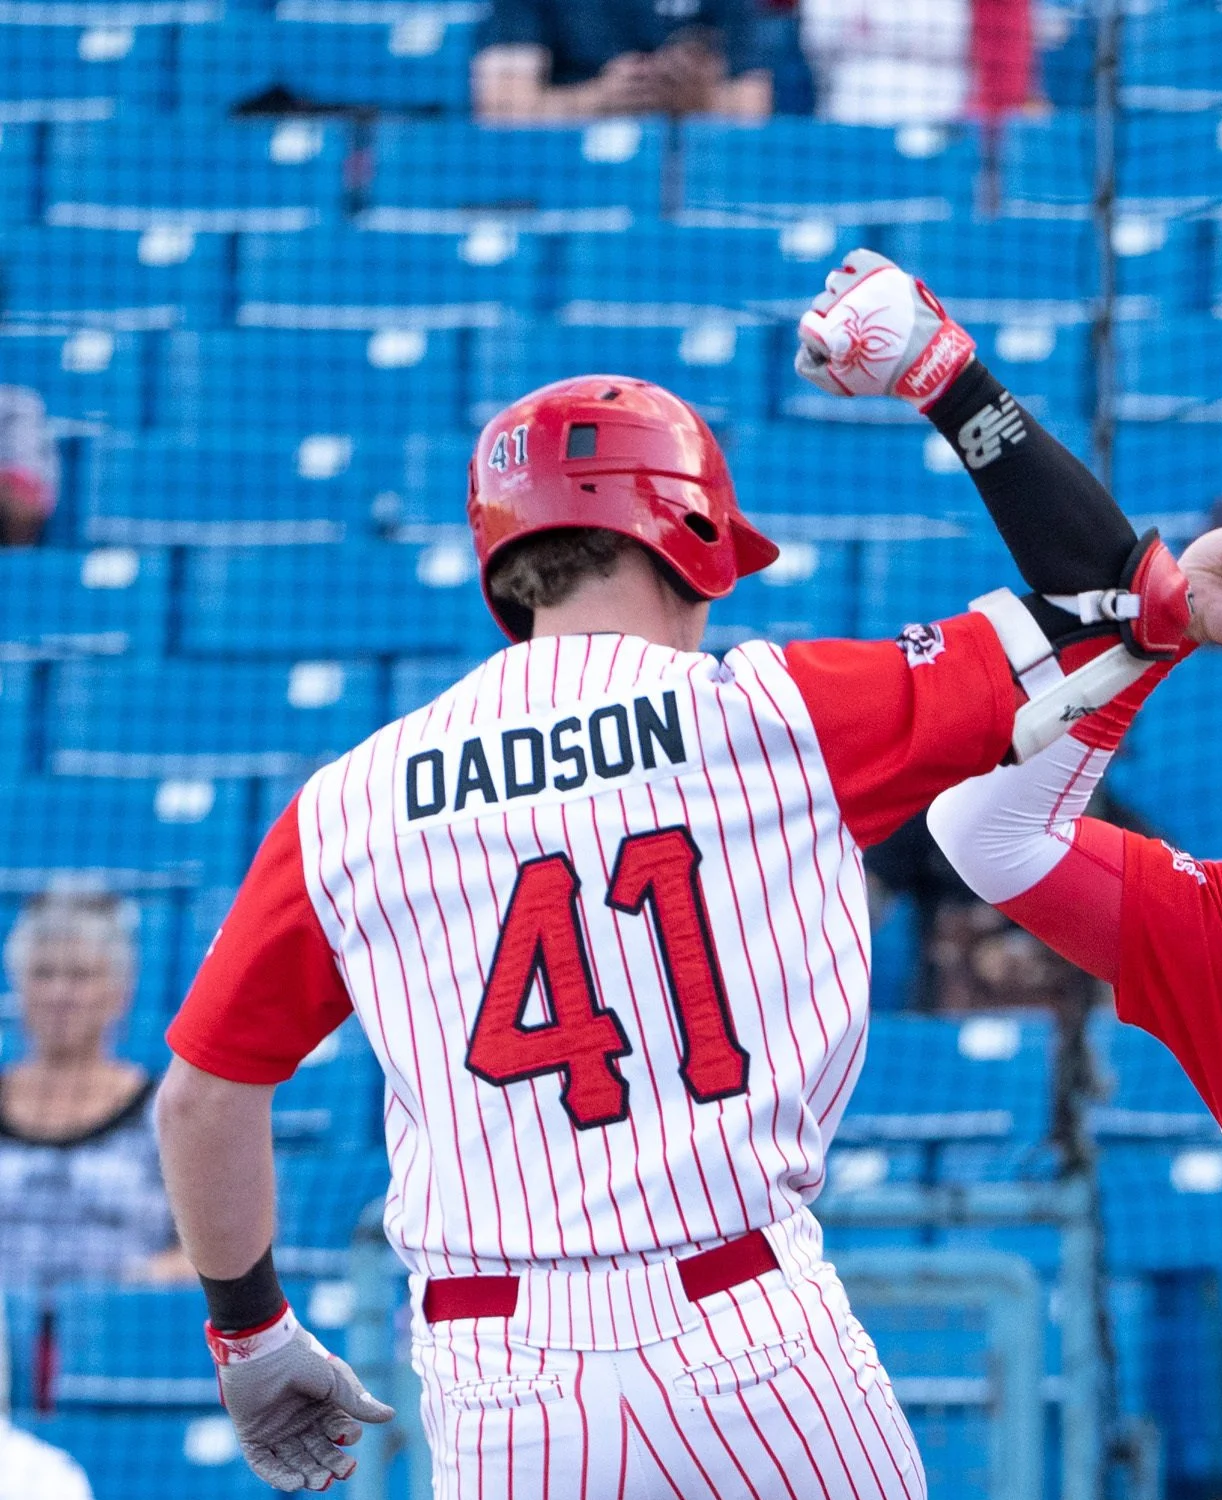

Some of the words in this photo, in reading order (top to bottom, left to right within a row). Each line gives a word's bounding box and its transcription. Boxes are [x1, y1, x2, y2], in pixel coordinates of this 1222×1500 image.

[488, 424, 529, 473] 41
[406, 690, 687, 821] DADSON
[464, 824, 751, 1131] 41
